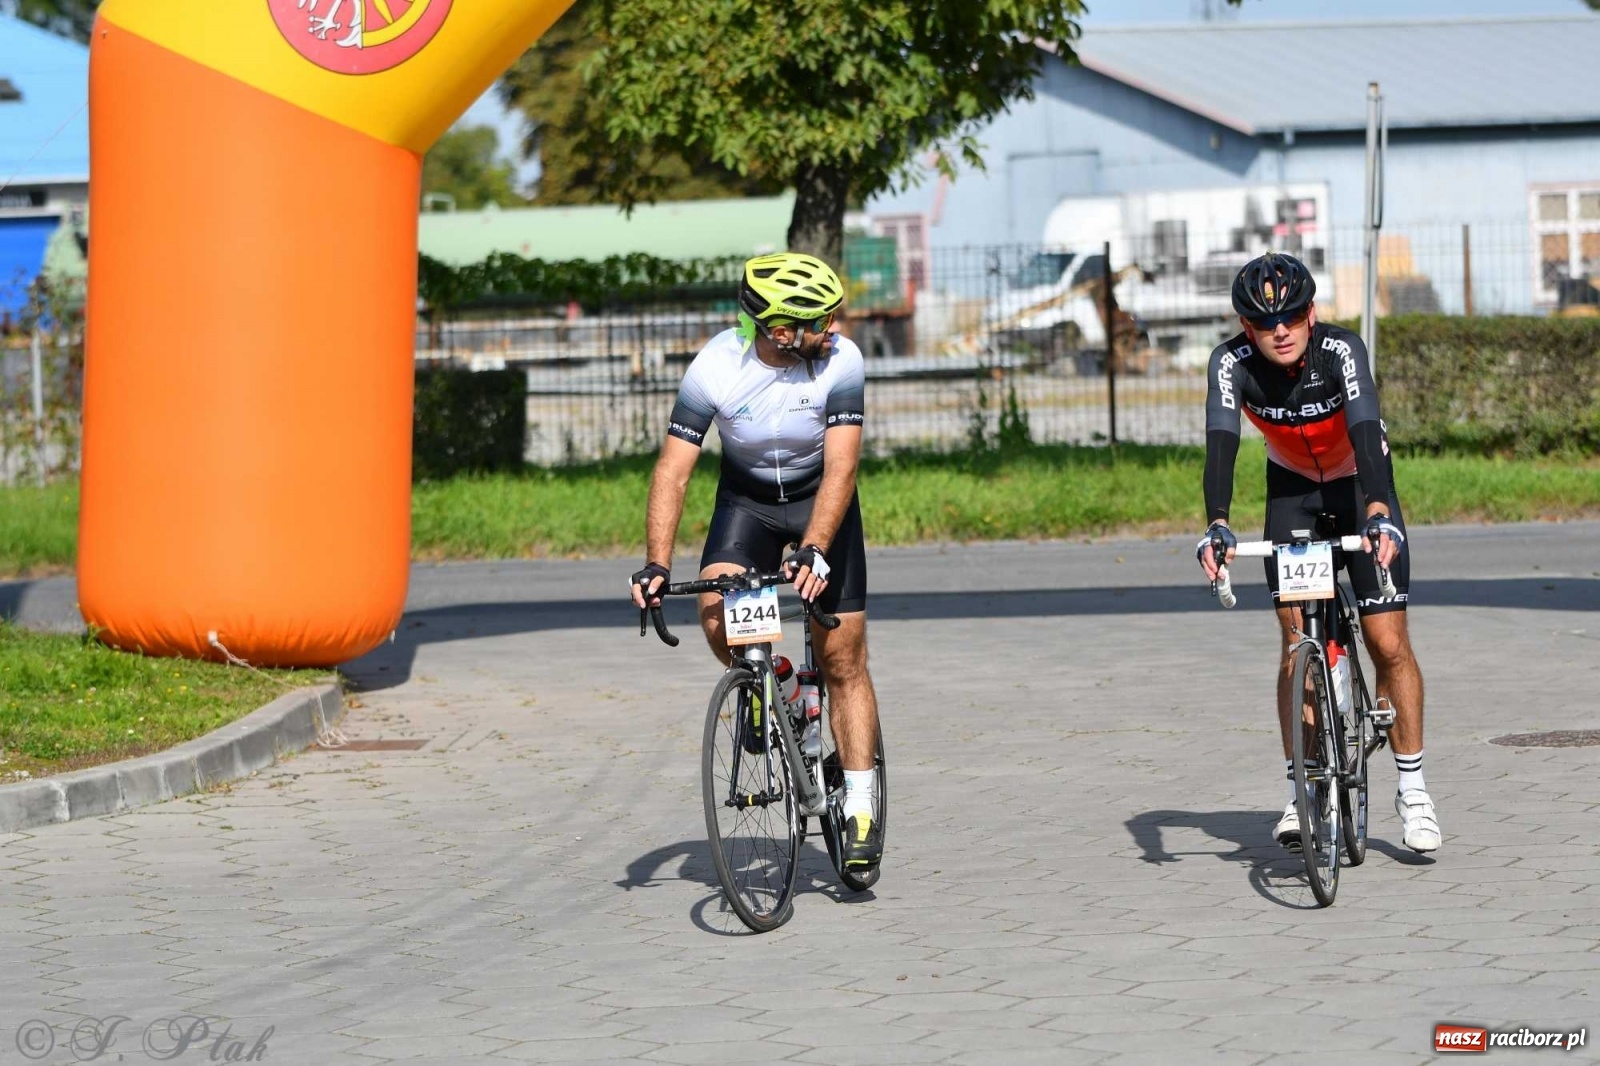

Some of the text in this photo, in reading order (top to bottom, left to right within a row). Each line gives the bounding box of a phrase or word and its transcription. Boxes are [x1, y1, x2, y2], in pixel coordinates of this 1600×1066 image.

[1217, 345, 1253, 410] DAR-BUD
[1322, 337, 1361, 401] DAR-BUD
[672, 422, 702, 439] RUDY
[1283, 561, 1330, 580] 1472
[729, 604, 778, 624] 1244
